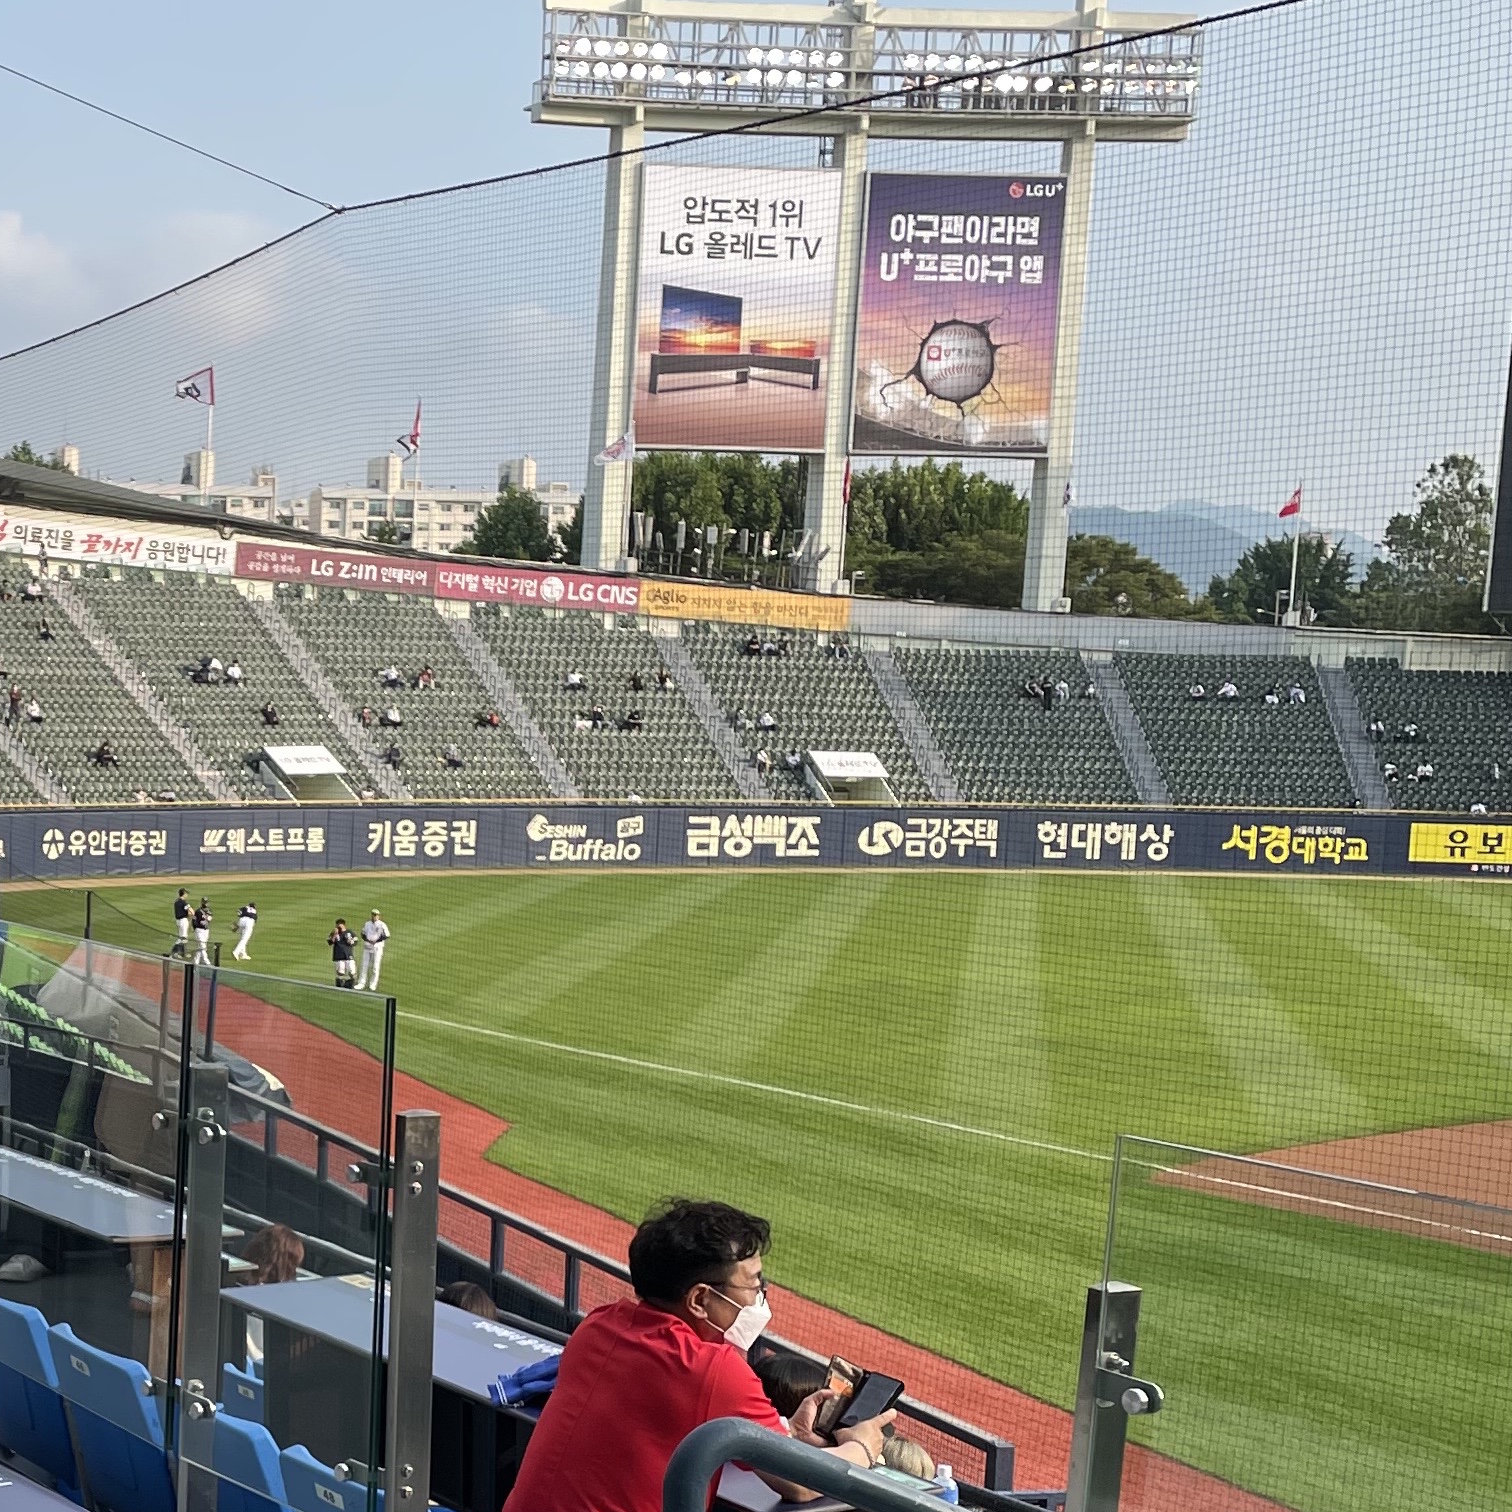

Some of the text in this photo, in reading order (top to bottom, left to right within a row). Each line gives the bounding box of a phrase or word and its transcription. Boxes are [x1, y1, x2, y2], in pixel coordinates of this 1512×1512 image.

[683, 196, 804, 229] 압도적 1위
[659, 231, 823, 260] LG 올레드 TV
[890, 213, 1041, 246] 야구팬이라면
[880, 248, 1045, 284] U+프로야구 앱
[12, 524, 75, 552] 의료진을
[80, 533, 144, 560] 끝까지
[146, 539, 227, 565] 응원합니다!
[311, 559, 334, 577] LG
[380, 567, 428, 586] 인테리어
[439, 571, 639, 606] 디지털 혁신 기업 LG CNS
[776, 605, 809, 619] 마신다
[67, 829, 168, 857] 유안타증권
[225, 827, 326, 855] 웨스트프롬
[367, 819, 478, 859] 키움증권
[538, 823, 588, 840] SESHIN
[686, 814, 821, 858] 금성백조
[904, 817, 1000, 859] 금강주택
[1037, 820, 1175, 861] 현대해상
[1221, 823, 1370, 865] 서경대학교
[1443, 829, 1506, 858] 유보
[549, 839, 642, 862] Buffalo
